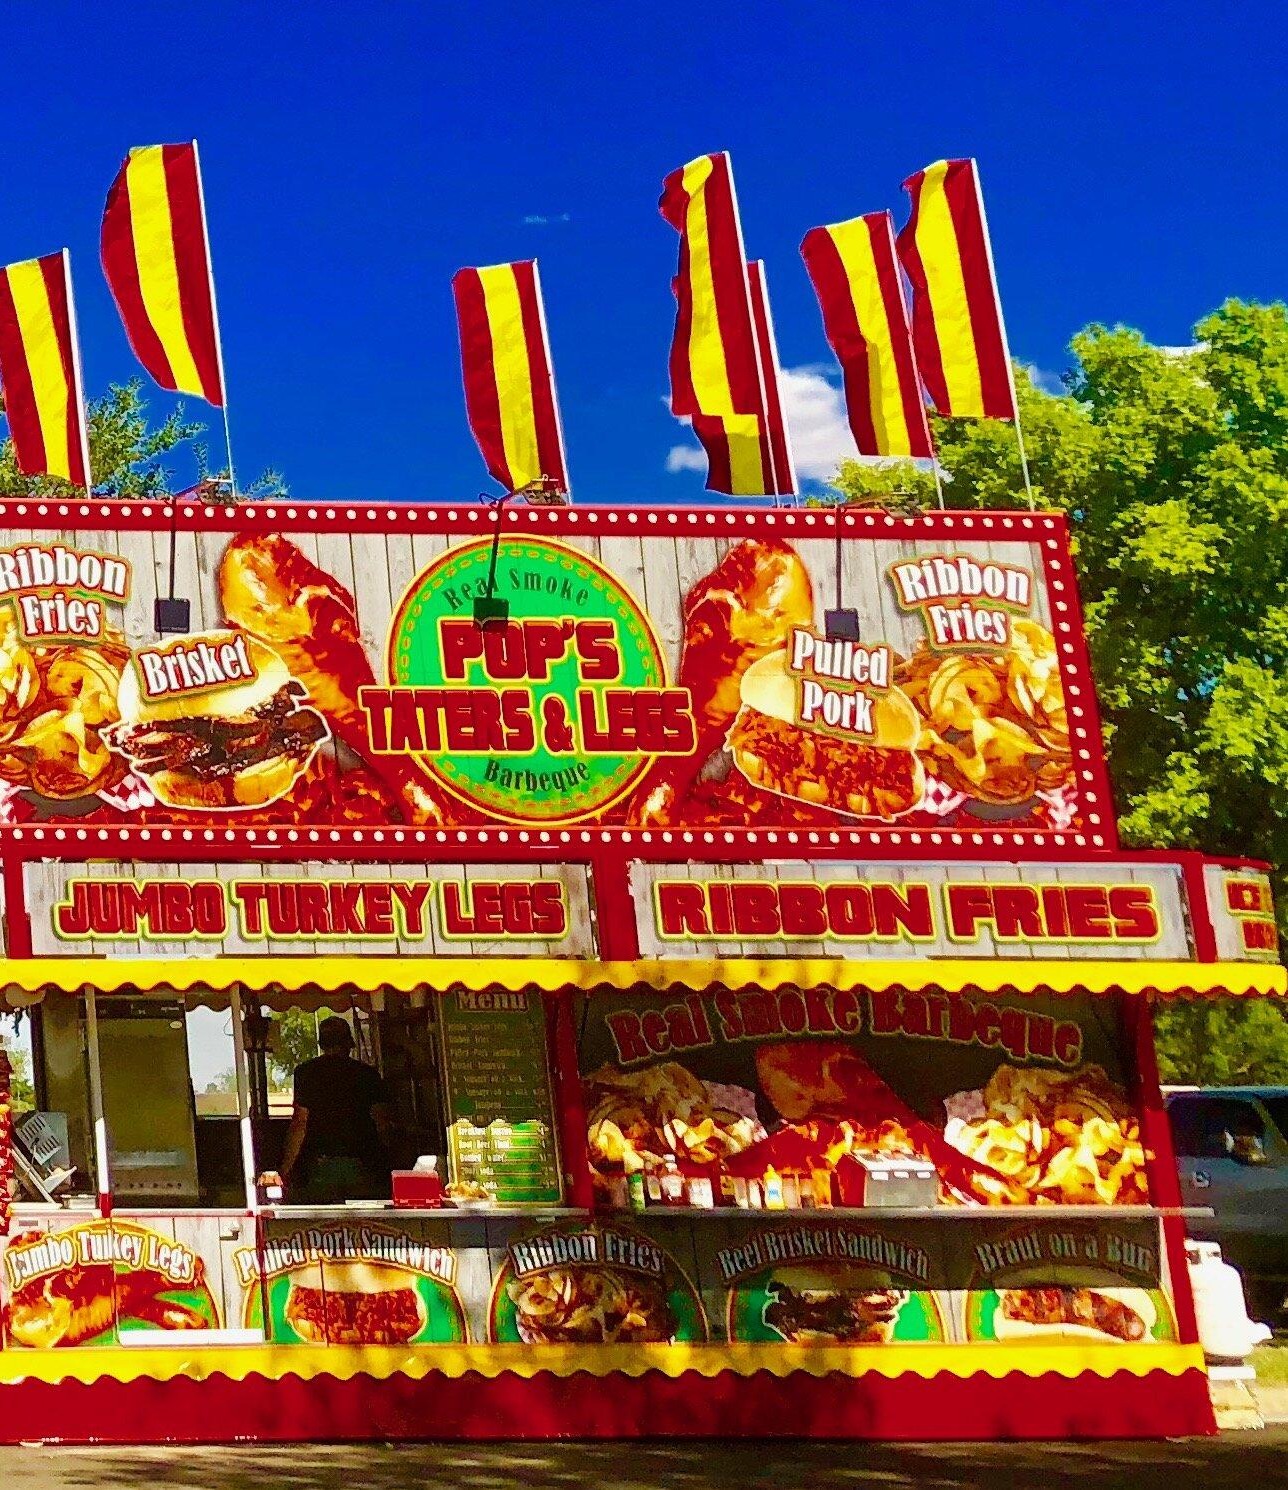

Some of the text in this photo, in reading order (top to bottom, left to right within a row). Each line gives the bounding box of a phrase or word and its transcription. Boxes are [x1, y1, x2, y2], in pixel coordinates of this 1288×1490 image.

[442, 567, 590, 612] Real Smoke
[894, 557, 1029, 606] Ribbon
[20, 593, 101, 636] Fries
[928, 602, 1007, 644] Fries
[140, 635, 253, 695] Brisket
[440, 618, 622, 681] POP'S
[791, 629, 888, 688] Pulled
[361, 688, 696, 753] TATERS & LEGS
[801, 680, 873, 734] Pork
[484, 759, 591, 793] Barbeque
[58, 881, 567, 937] JUMBO TURKEY LEGS
[658, 883, 1161, 939] RIBBON FRIES
[458, 989, 527, 1009] Menu
[606, 989, 1084, 1066] Real Smoke Barbeque
[9, 1235, 73, 1285] Jumbo
[148, 1234, 193, 1280] Legs
[308, 1228, 356, 1260] Pork
[361, 1228, 453, 1281] Sandwich
[512, 1232, 663, 1273] Ribbon Fries
[764, 1227, 834, 1262] Brisket
[837, 1226, 929, 1280] Sandwich
